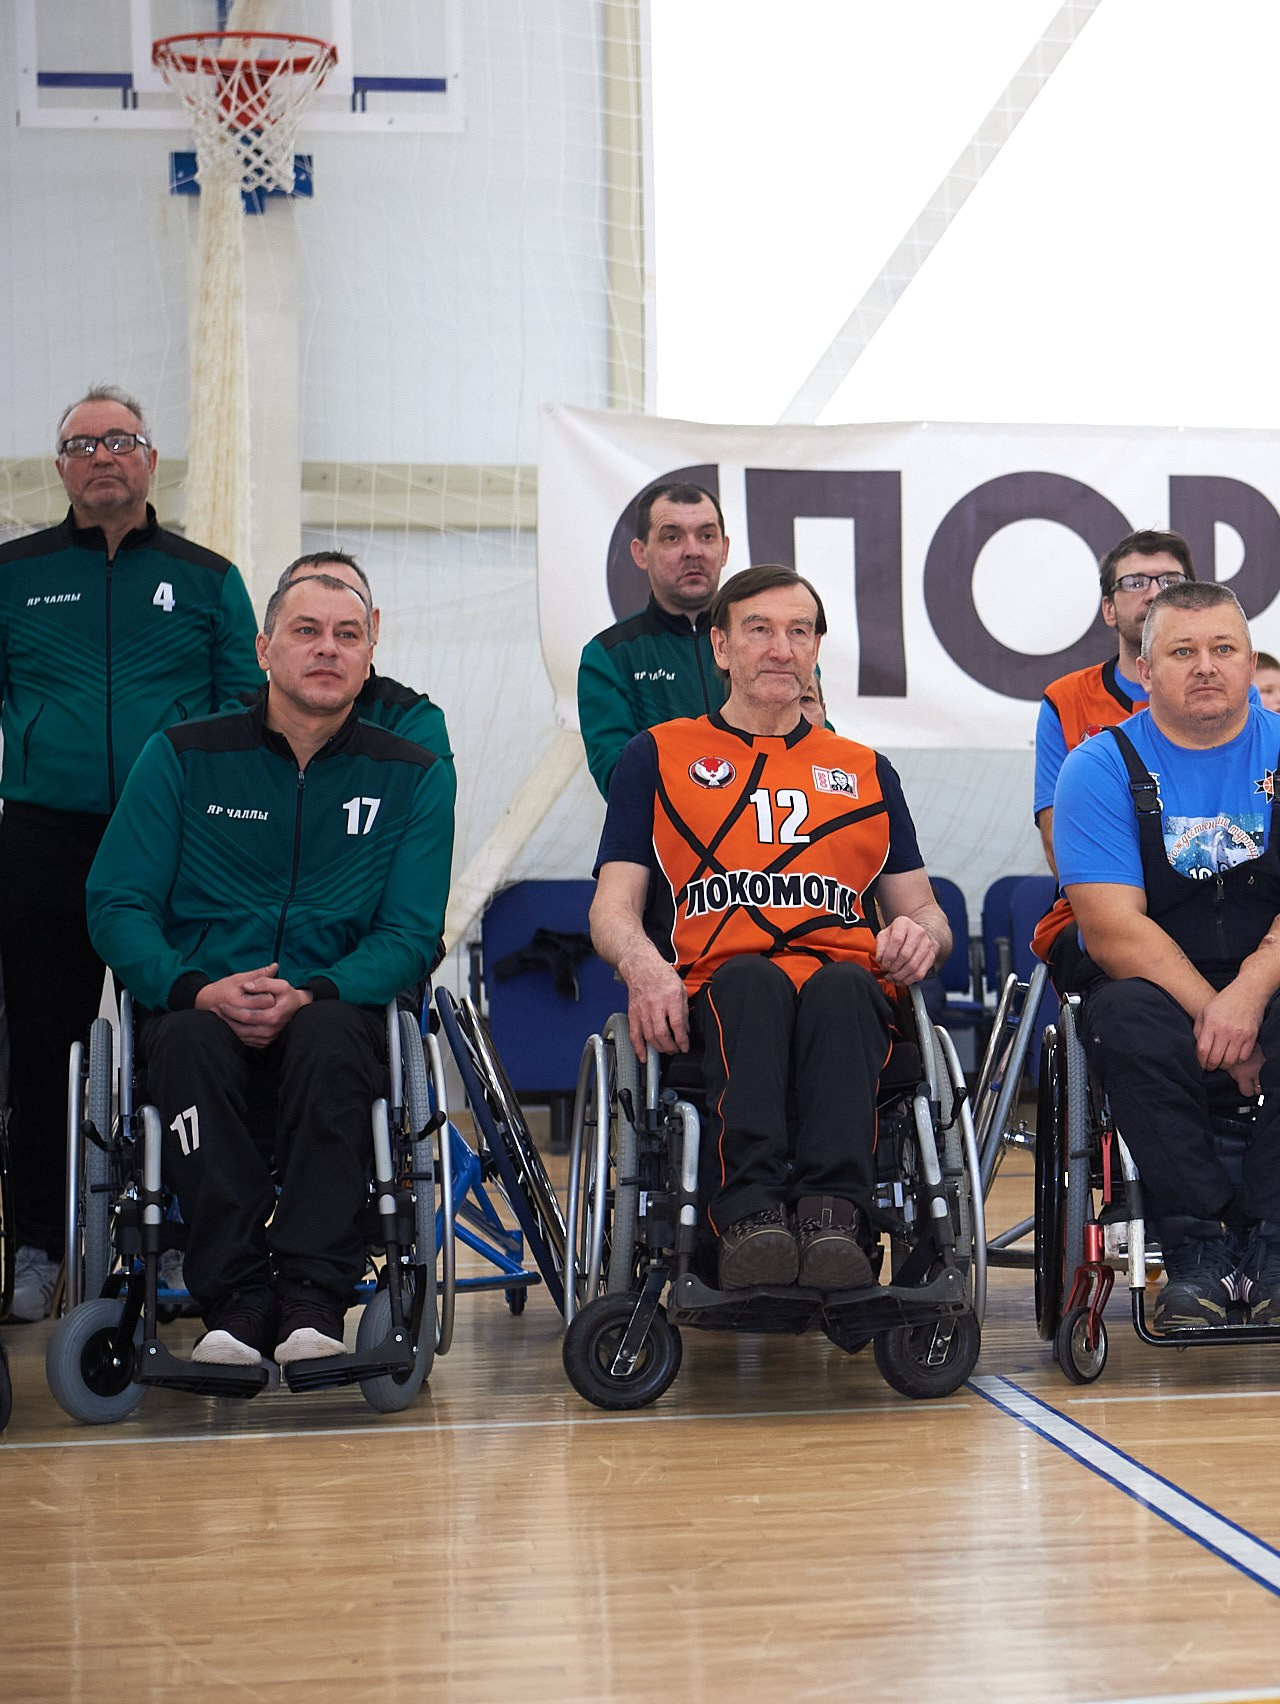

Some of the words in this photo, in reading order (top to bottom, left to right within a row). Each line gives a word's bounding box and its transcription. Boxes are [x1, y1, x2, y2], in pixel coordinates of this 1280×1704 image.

[43, 592, 81, 605] ЧАЛЛЫ
[152, 581, 176, 612] 4
[206, 804, 224, 815] ЯР
[226, 807, 270, 821] ЧАЛЛЫ
[342, 797, 381, 835] 17
[750, 788, 810, 844] 12
[685, 869, 860, 924] ЛОКОМОТИ
[169, 1105, 200, 1156] 17
